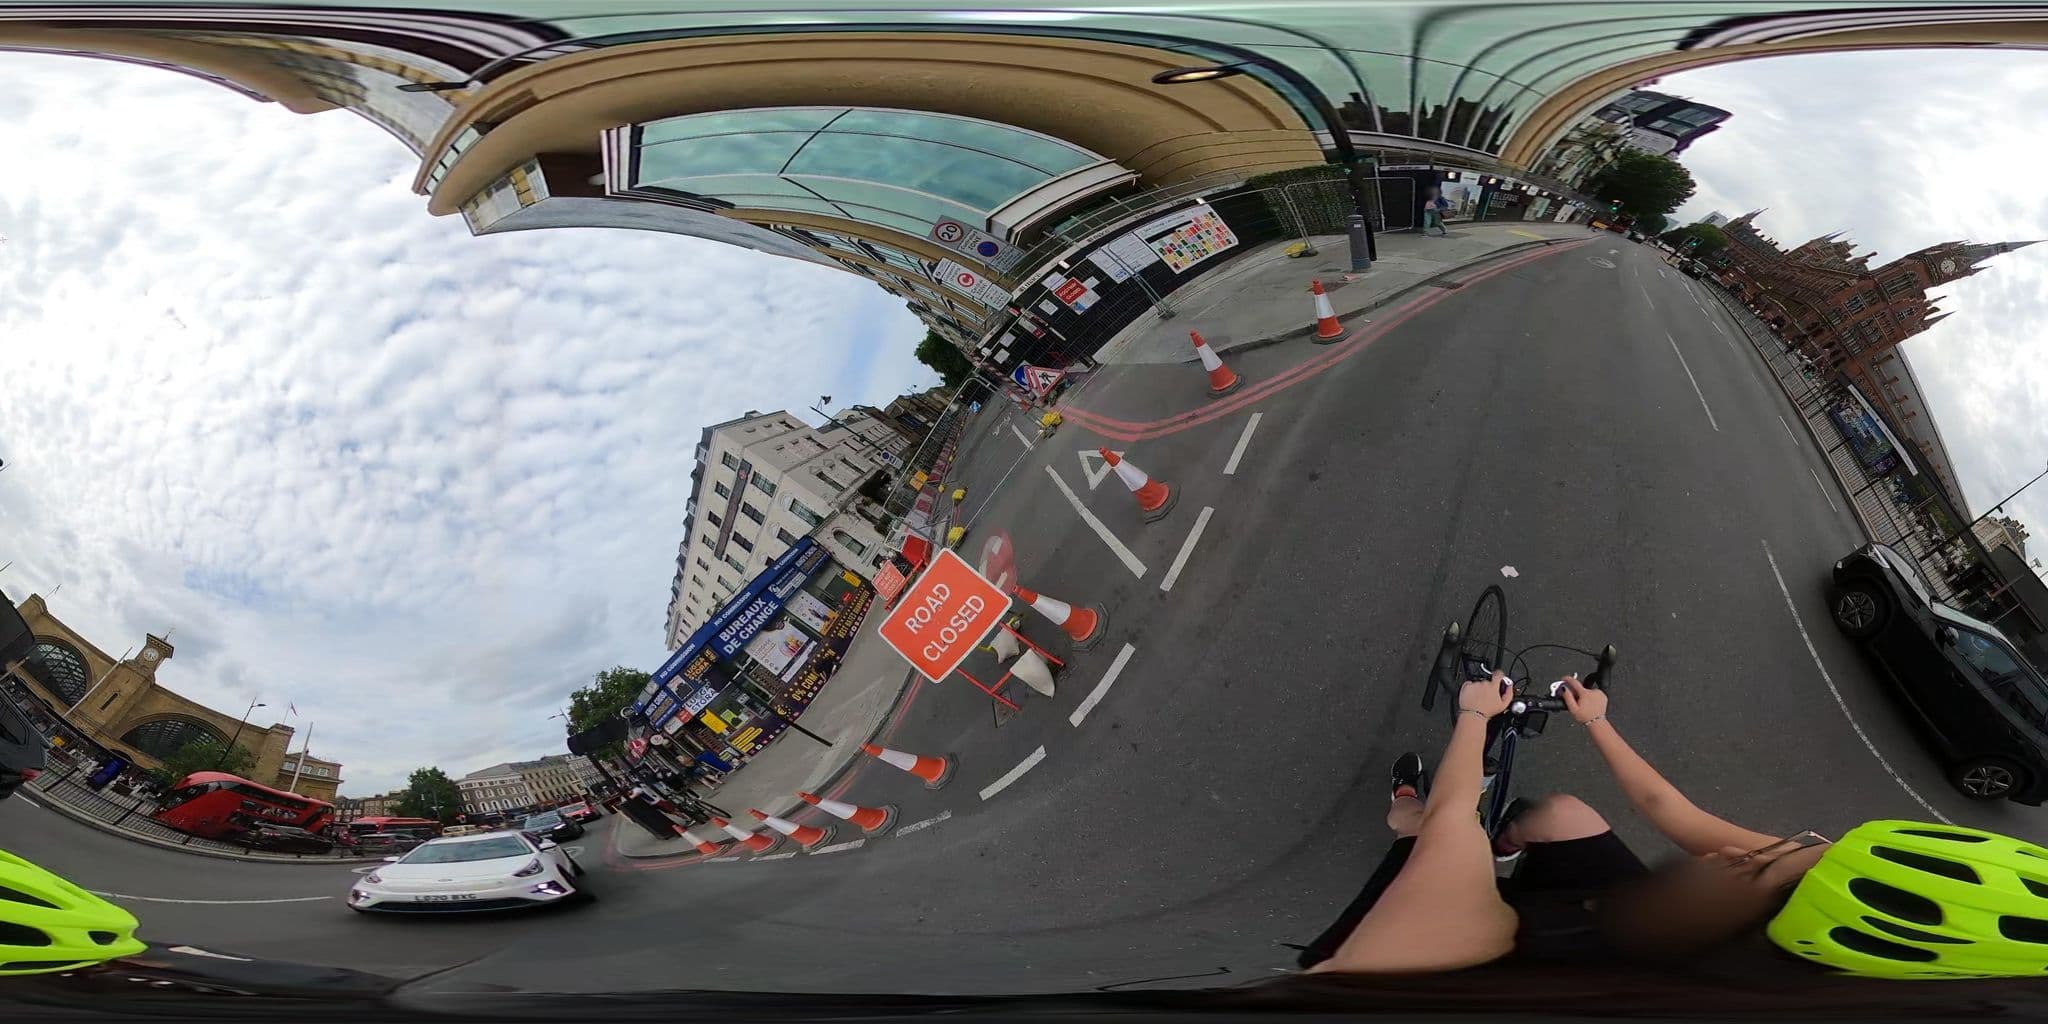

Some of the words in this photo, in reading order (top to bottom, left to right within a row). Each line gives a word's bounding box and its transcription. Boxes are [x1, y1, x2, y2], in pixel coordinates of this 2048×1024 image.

[942, 224, 958, 240] 20
[968, 236, 982, 250] ZONE
[717, 596, 766, 642] BUREAUX
[722, 636, 742, 655] DE
[737, 599, 779, 640] CHANGE
[904, 582, 951, 635] ROAD
[923, 594, 986, 662] CLOSED
[791, 686, 806, 701] 0%
